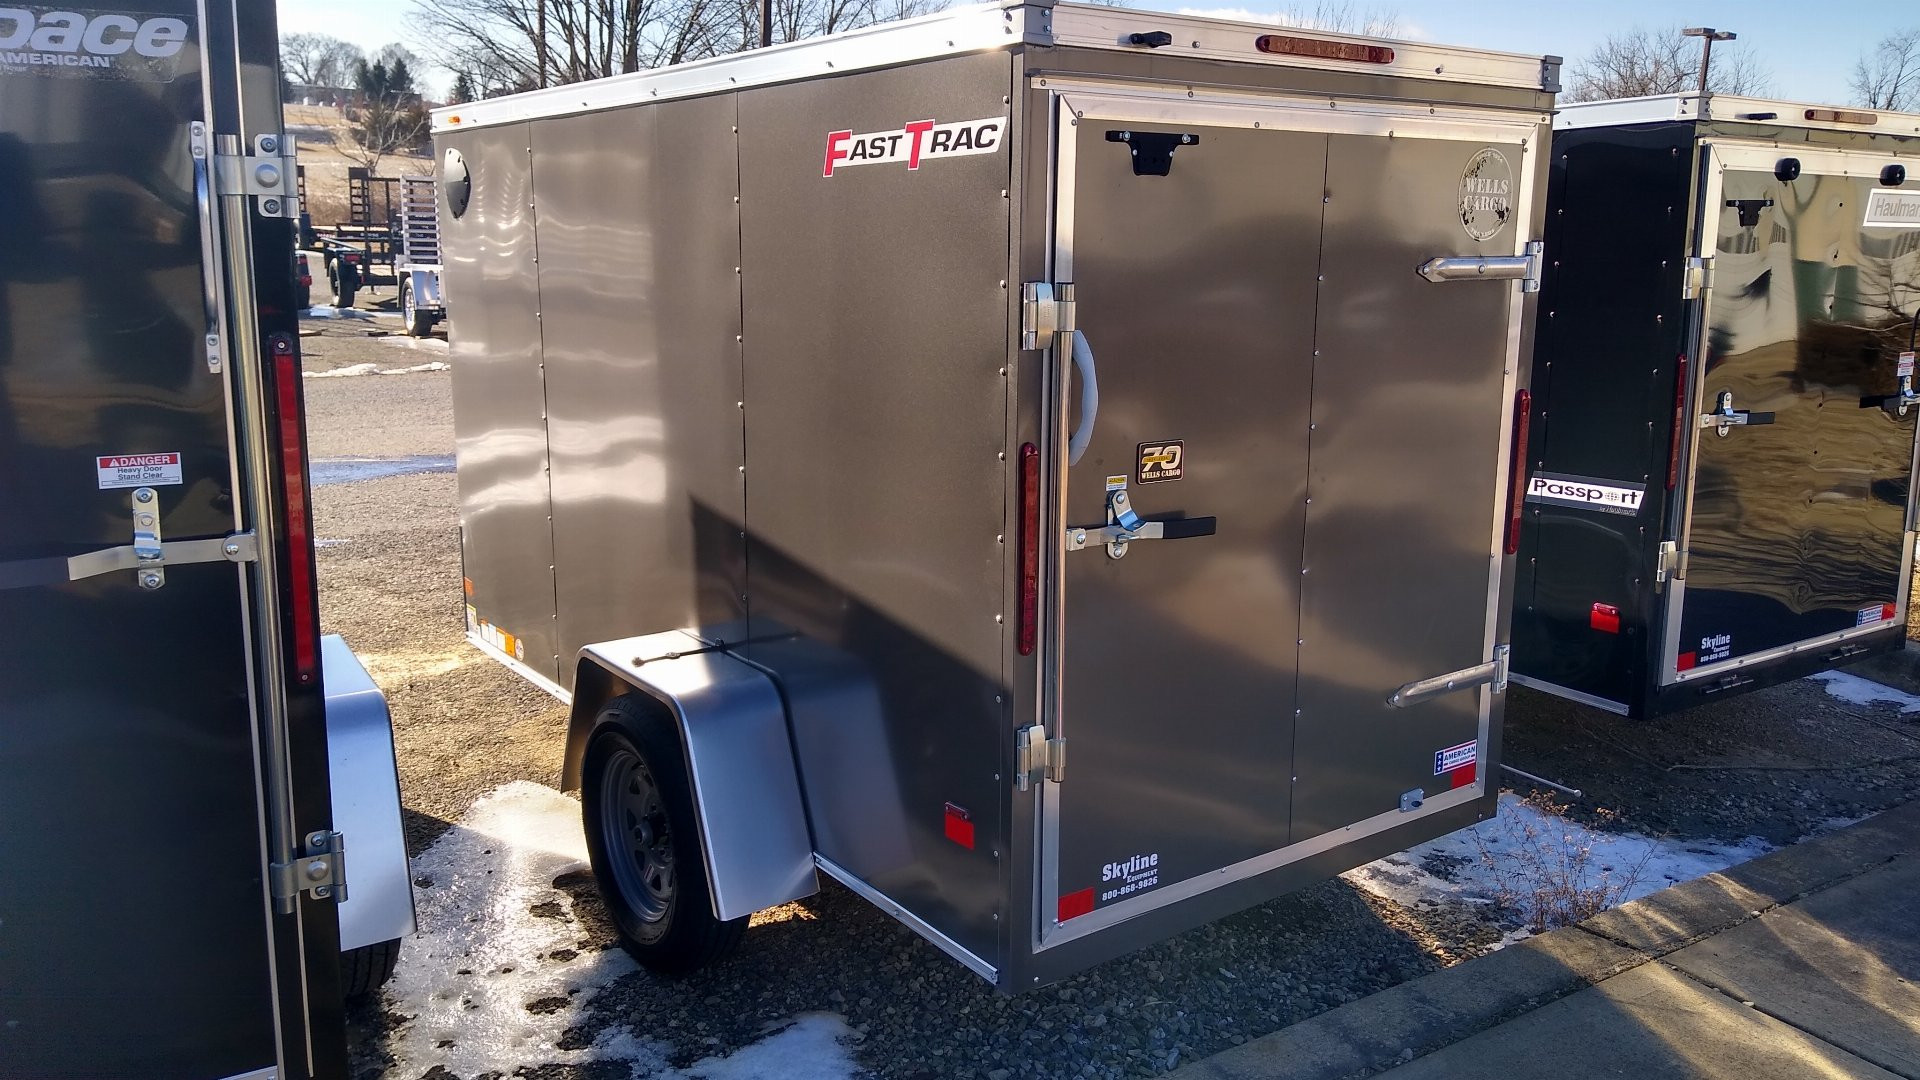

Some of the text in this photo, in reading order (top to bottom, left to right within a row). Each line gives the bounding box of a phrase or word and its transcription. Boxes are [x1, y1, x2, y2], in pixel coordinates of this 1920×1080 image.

[824, 120, 998, 176] FAST TRAC
[1466, 178, 1509, 194] WELLS
[1464, 195, 1507, 211] CARGO
[1874, 197, 1920, 217] Haulmar
[120, 456, 171, 467] DANGER
[1142, 446, 1181, 472] 70
[118, 467, 142, 475] Heavy
[1142, 468, 1181, 480] WELLS CARGO
[1702, 634, 1730, 649] Skyline
[1444, 745, 1476, 762] AMERICAN
[1102, 853, 1158, 881] Skyline
